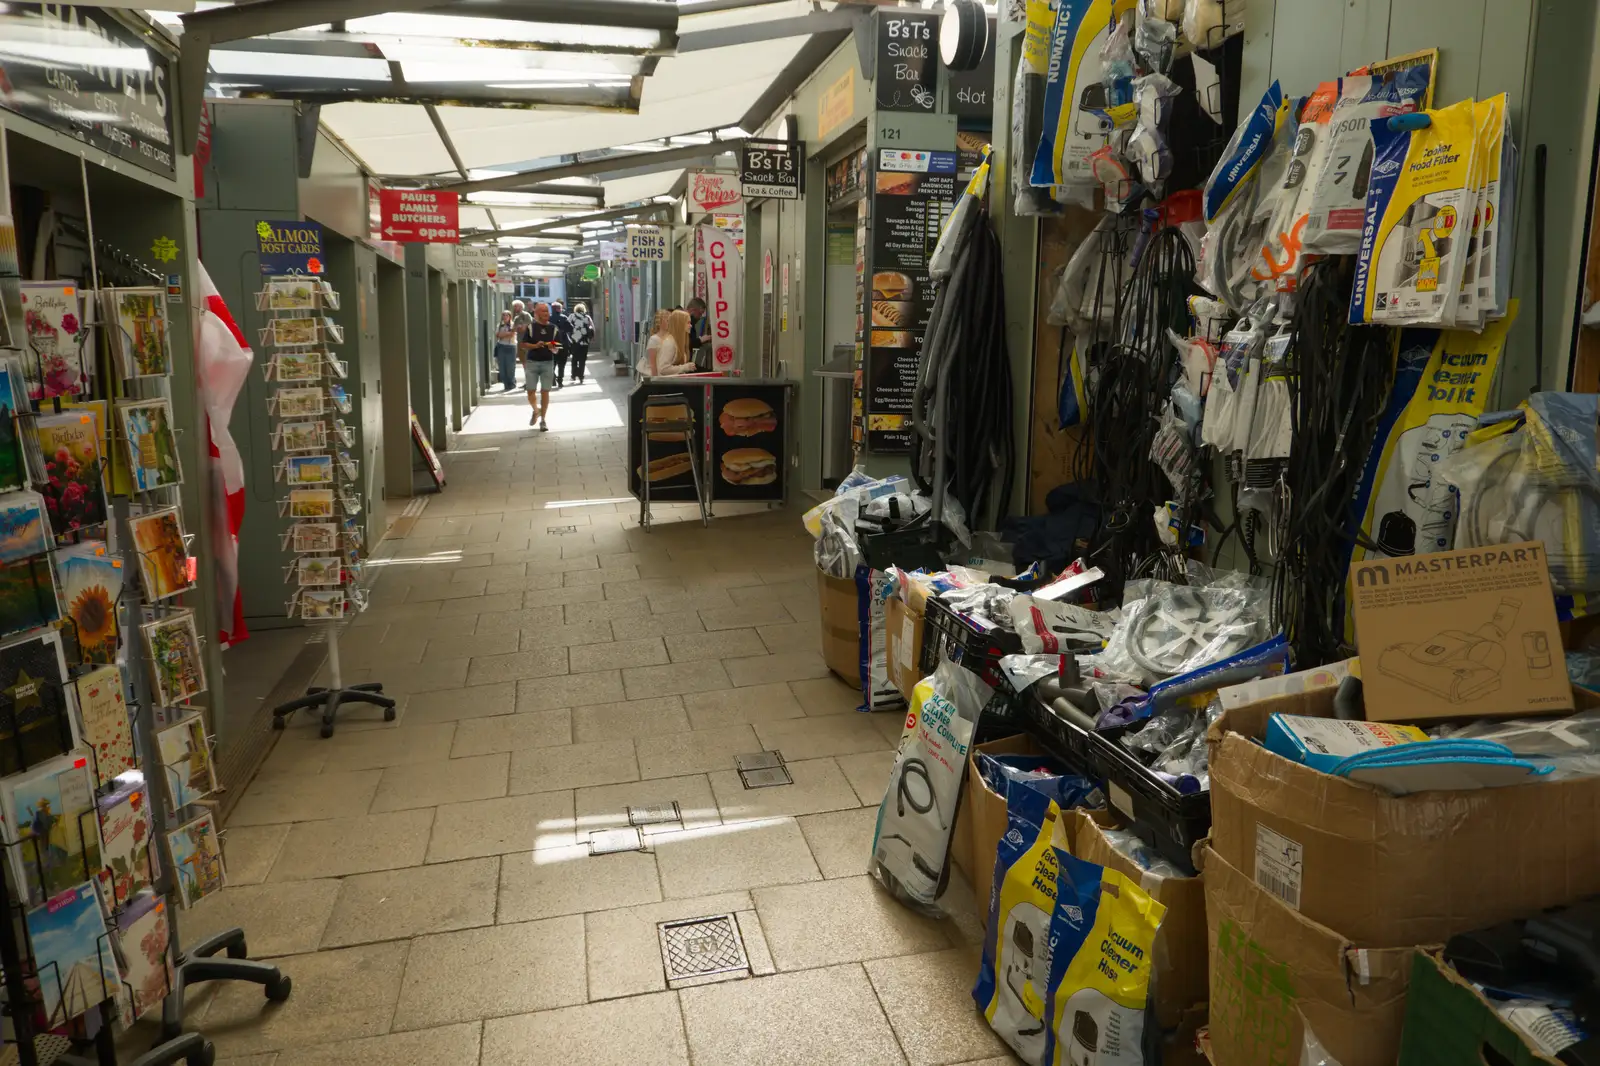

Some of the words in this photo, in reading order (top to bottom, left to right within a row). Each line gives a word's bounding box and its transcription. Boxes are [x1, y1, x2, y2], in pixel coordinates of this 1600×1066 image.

[887, 43, 929, 59] Snack
[1047, 9, 1071, 83] NUMATIC
[893, 63, 920, 81] Bar
[45, 67, 79, 98] CARDS
[956, 86, 987, 105] Hot
[880, 128, 901, 140] 121
[139, 140, 153, 158] POST
[153, 149, 171, 166] CARDS
[1226, 131, 1264, 183] UNIVERSAL
[1434, 153, 1461, 167] Filter
[744, 171, 774, 183] Snack
[778, 171, 796, 184] Bar
[1289, 164, 1302, 186] METRE
[693, 185, 741, 203] Chips
[747, 186, 760, 195] Tea
[761, 187, 768, 196] &
[769, 187, 794, 196] Coffee
[920, 182, 954, 190] SANDWICHES
[400, 192, 437, 203] PAUL'S
[399, 204, 438, 213] FAMILY
[392, 214, 447, 224] BUTCHERS
[886, 217, 906, 225] Sausage
[418, 227, 457, 240] open
[631, 236, 656, 247] FISH
[657, 236, 665, 247] &
[260, 242, 287, 255] POST
[288, 243, 321, 255] CARDS
[456, 247, 478, 257] China
[480, 247, 497, 258] Wok
[631, 248, 664, 259] CHIPS
[1352, 200, 1380, 307] UNIVERSAL
[457, 260, 485, 269] CHINESE
[709, 240, 731, 339] CHIPS
[51, 428, 86, 445] Birthday
[1395, 546, 1541, 577] MASTERPART
[1342, 720, 1361, 739] SEBO
[1034, 860, 1058, 882] Clea
[1032, 876, 1058, 901] Hose
[1100, 940, 1138, 974] Cleaner
